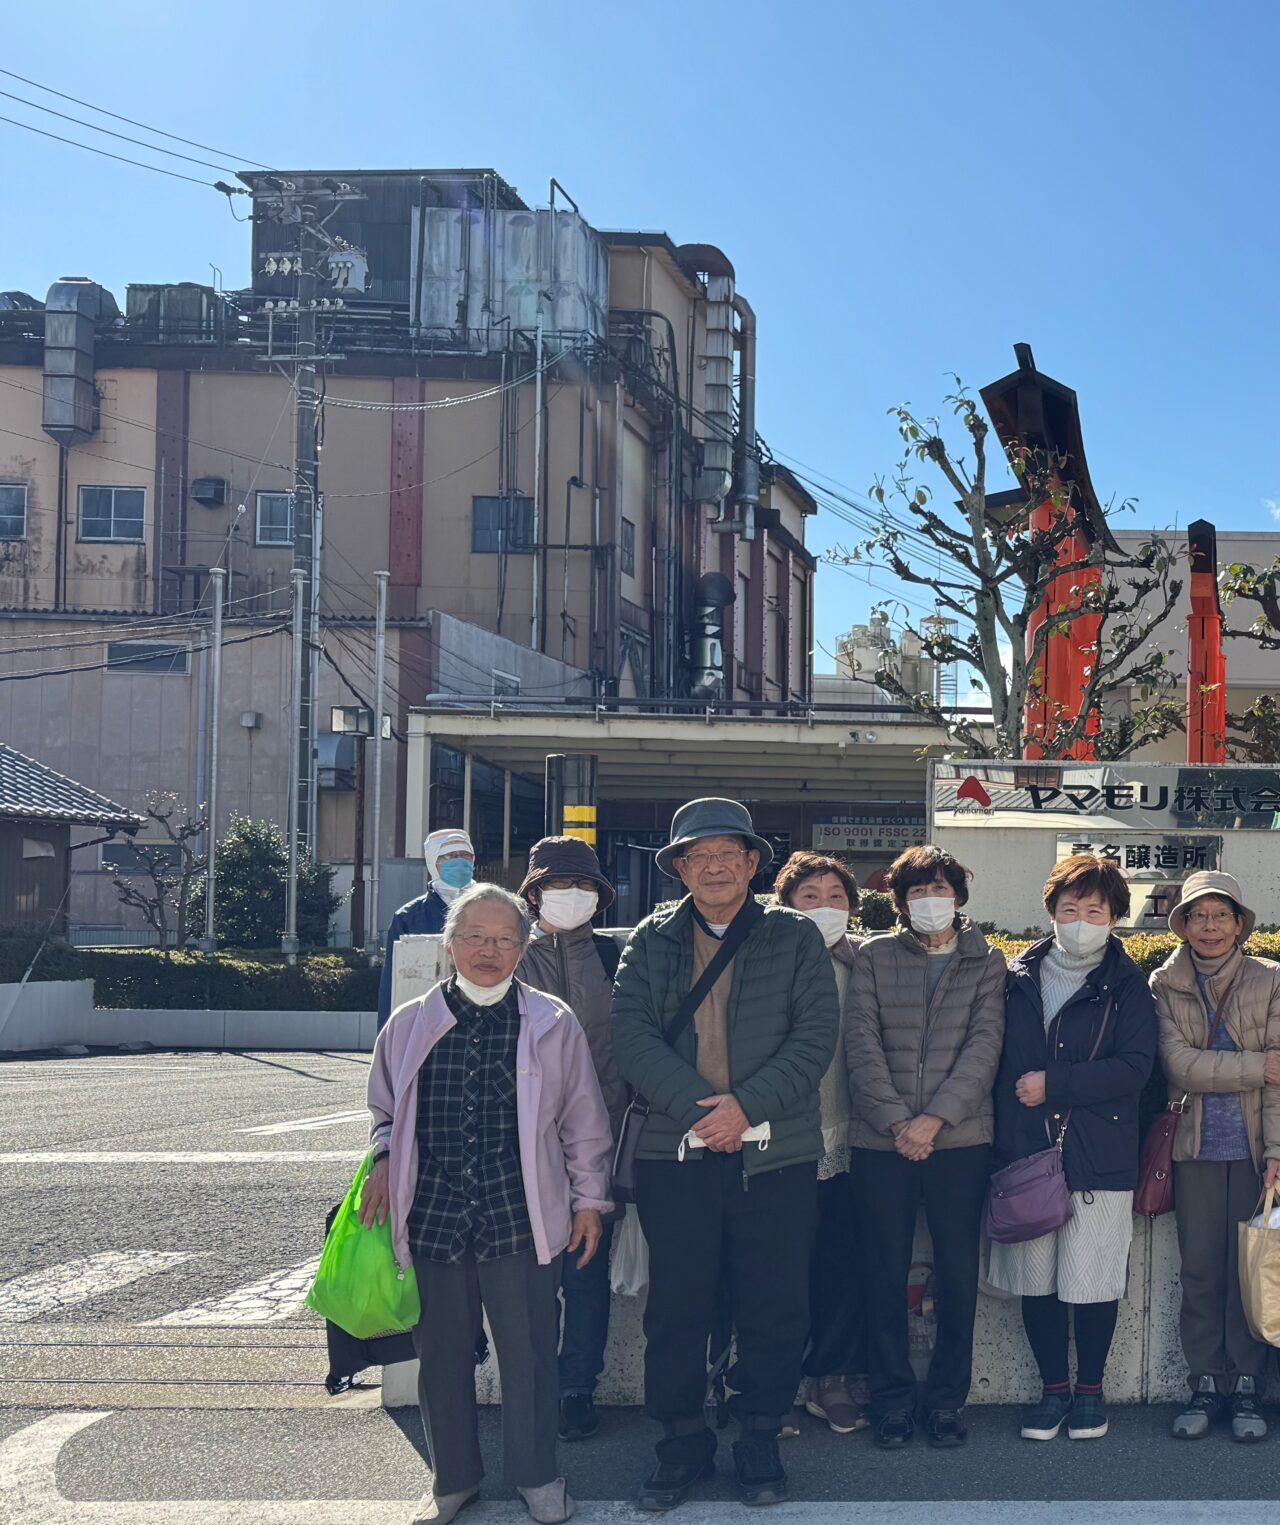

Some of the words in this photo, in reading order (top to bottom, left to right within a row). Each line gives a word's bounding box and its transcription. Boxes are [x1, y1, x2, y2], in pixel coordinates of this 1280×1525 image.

[819, 827, 841, 837] ISO
[844, 827, 873, 837] 9001
[878, 828, 909, 838] FSSC
